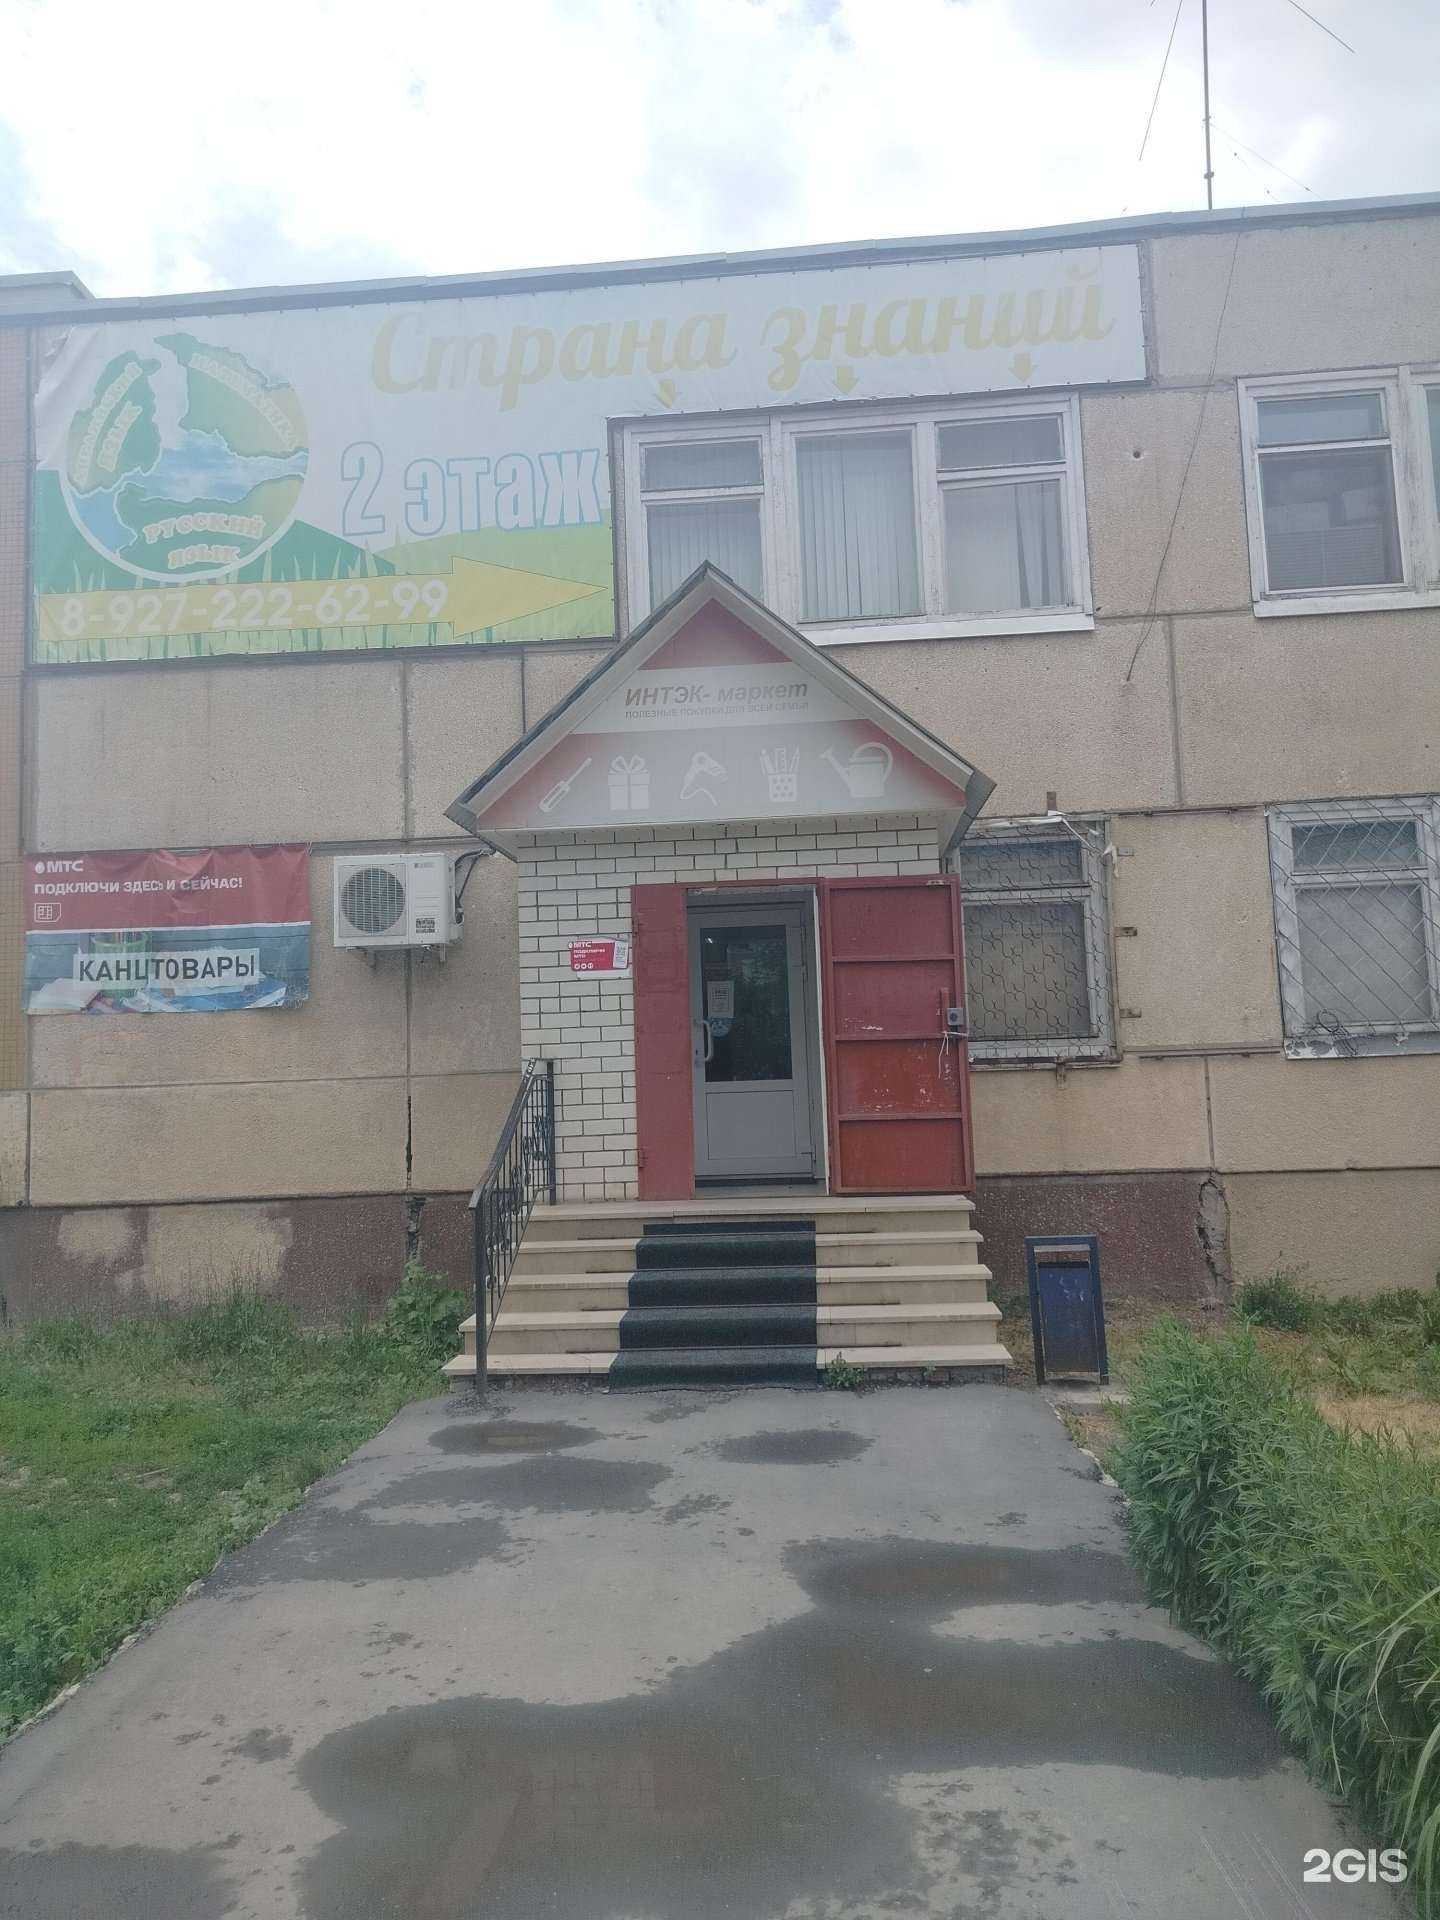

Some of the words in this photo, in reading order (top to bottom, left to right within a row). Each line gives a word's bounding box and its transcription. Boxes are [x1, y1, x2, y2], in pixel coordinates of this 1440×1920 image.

[371, 311, 738, 412] Страна
[760, 263, 1116, 392] знаний
[341, 441, 385, 536] 2
[404, 449, 601, 536] этаж
[143, 512, 265, 544] РУССКИЙ
[60, 578, 448, 635] 8-927-222-62-99
[718, 683, 807, 704] маркет
[47, 860, 84, 872] МТС
[34, 880, 119, 896] ПОДКЛЮЧИ
[123, 880, 164, 894] ЗДЕСЬ
[166, 880, 176, 890] И
[180, 876, 243, 891] СЕЙЧАС!
[79, 955, 255, 982] КАНЦТОВАРЫ
